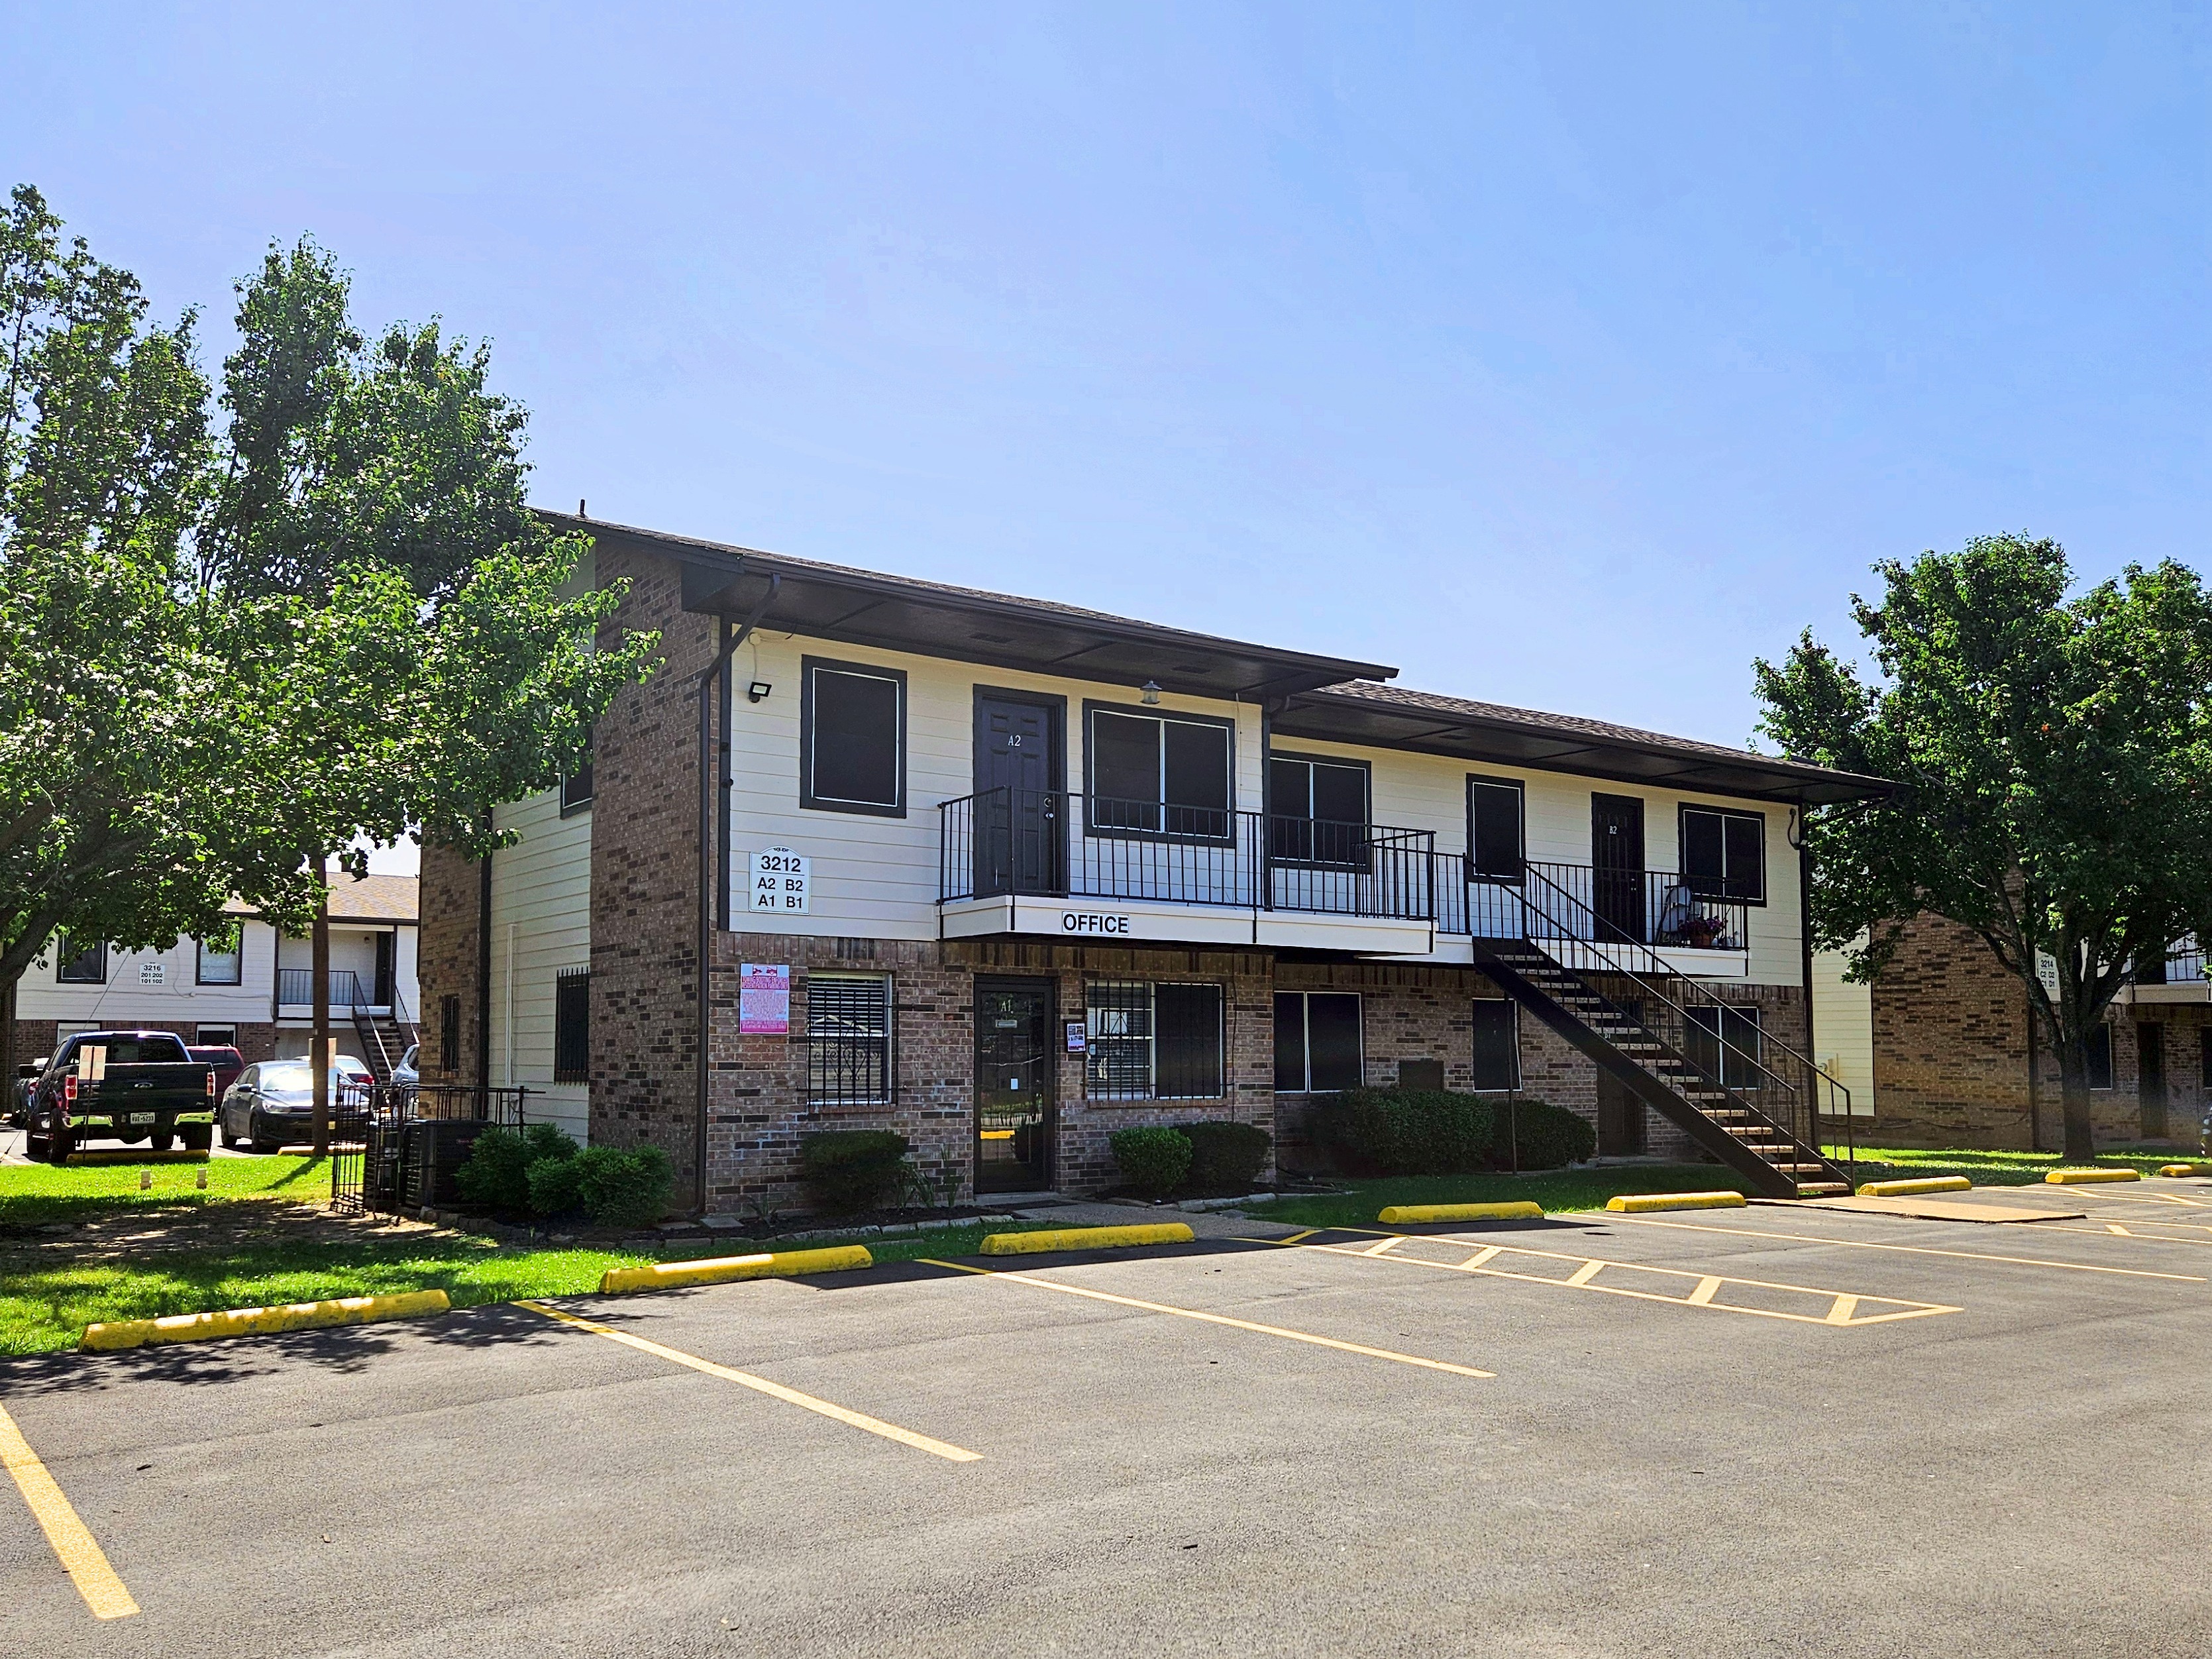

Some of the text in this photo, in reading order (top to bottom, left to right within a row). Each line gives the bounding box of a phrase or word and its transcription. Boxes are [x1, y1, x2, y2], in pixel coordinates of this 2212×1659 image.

[1008, 735, 1021, 747] A2
[1609, 826, 1617, 834] B2
[761, 855, 801, 873] 3212
[757, 877, 803, 892] A2 B2
[758, 894, 802, 908] A1 B1
[1063, 914, 1128, 934] OFFICE
[2040, 959, 2054, 968] 3214
